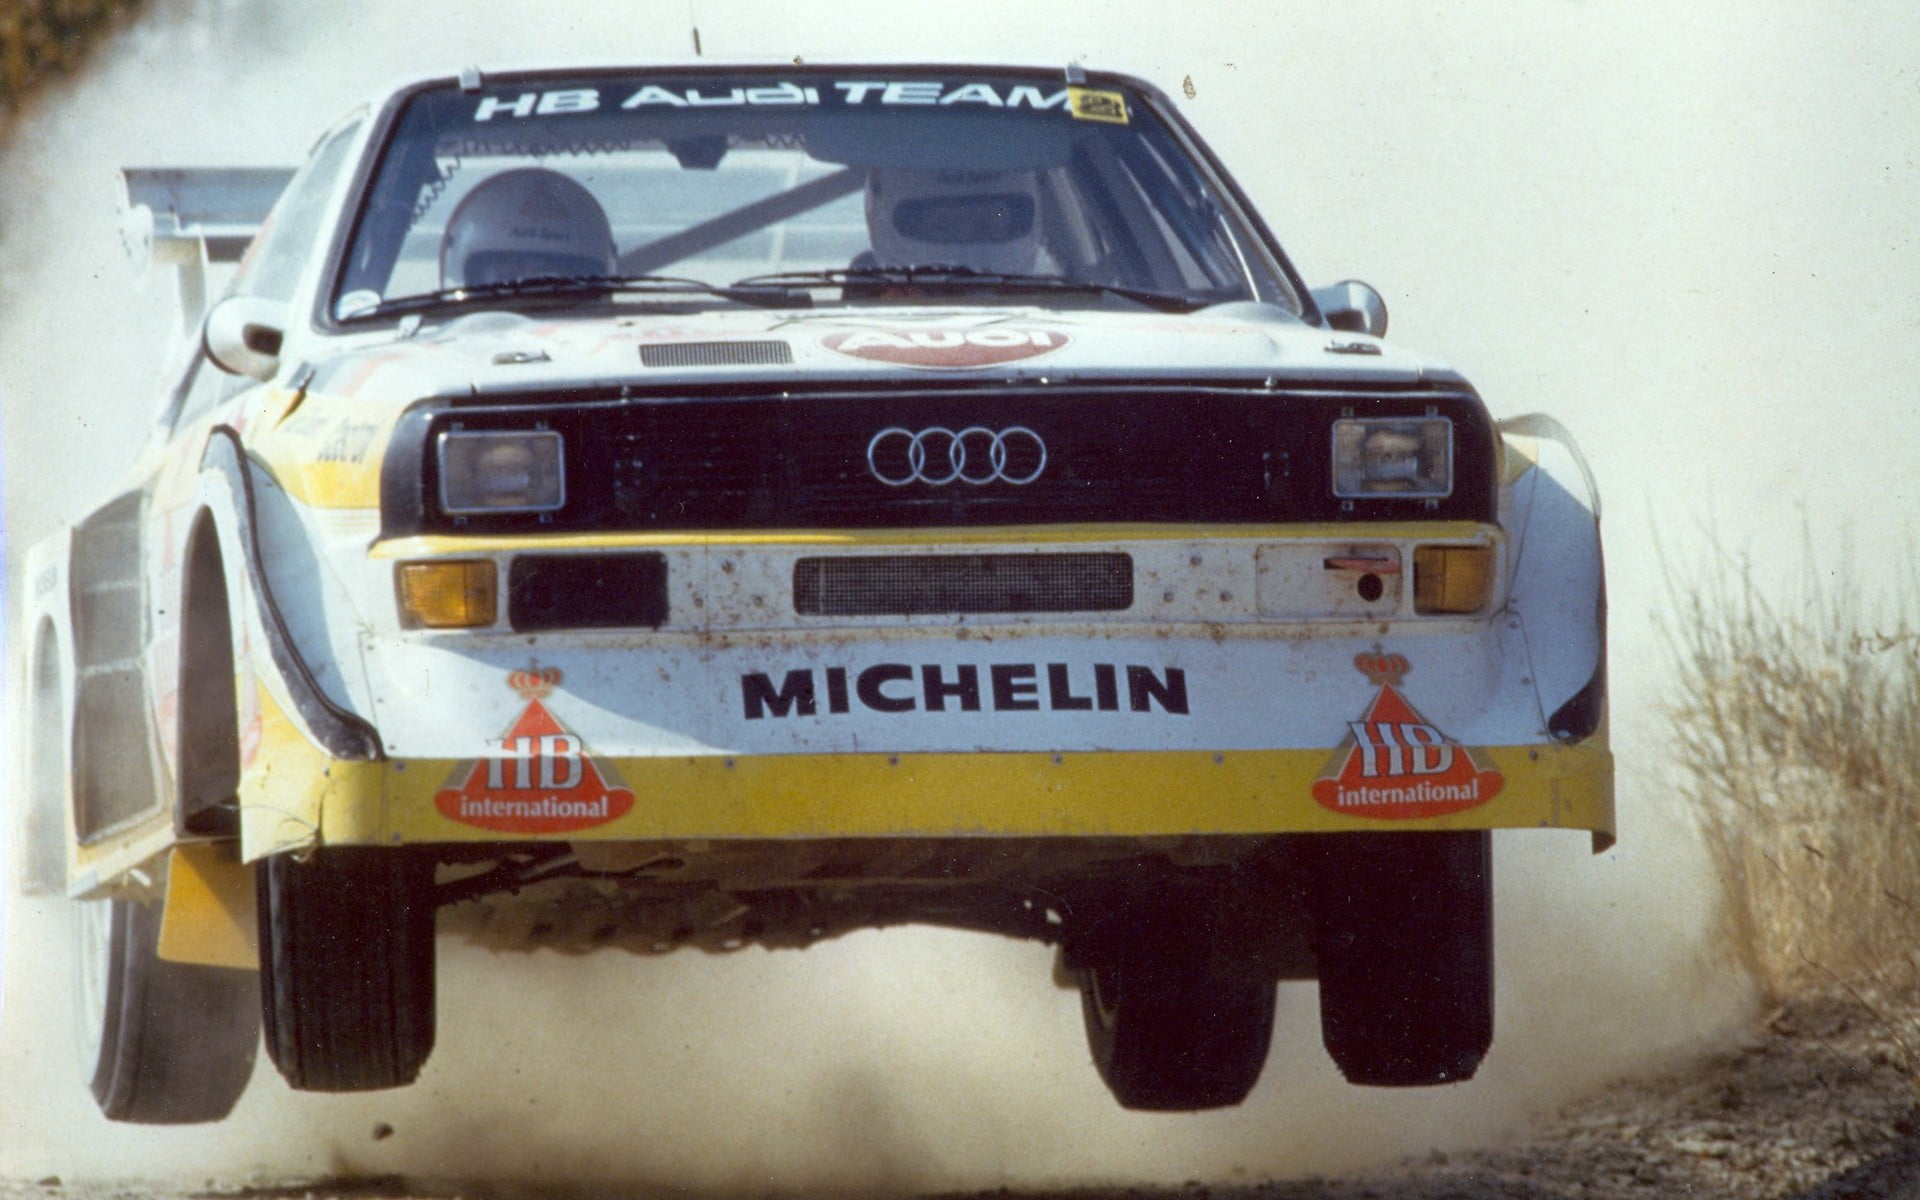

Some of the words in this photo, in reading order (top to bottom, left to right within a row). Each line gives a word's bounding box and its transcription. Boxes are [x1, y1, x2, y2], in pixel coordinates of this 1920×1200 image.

[474, 88, 600, 122] HB
[834, 81, 1073, 112] TEAM
[741, 662, 1190, 720] MICHELIN
[485, 732, 584, 790] HB
[1347, 720, 1454, 778] HB
[460, 795, 609, 818] international
[1338, 777, 1480, 807] international
